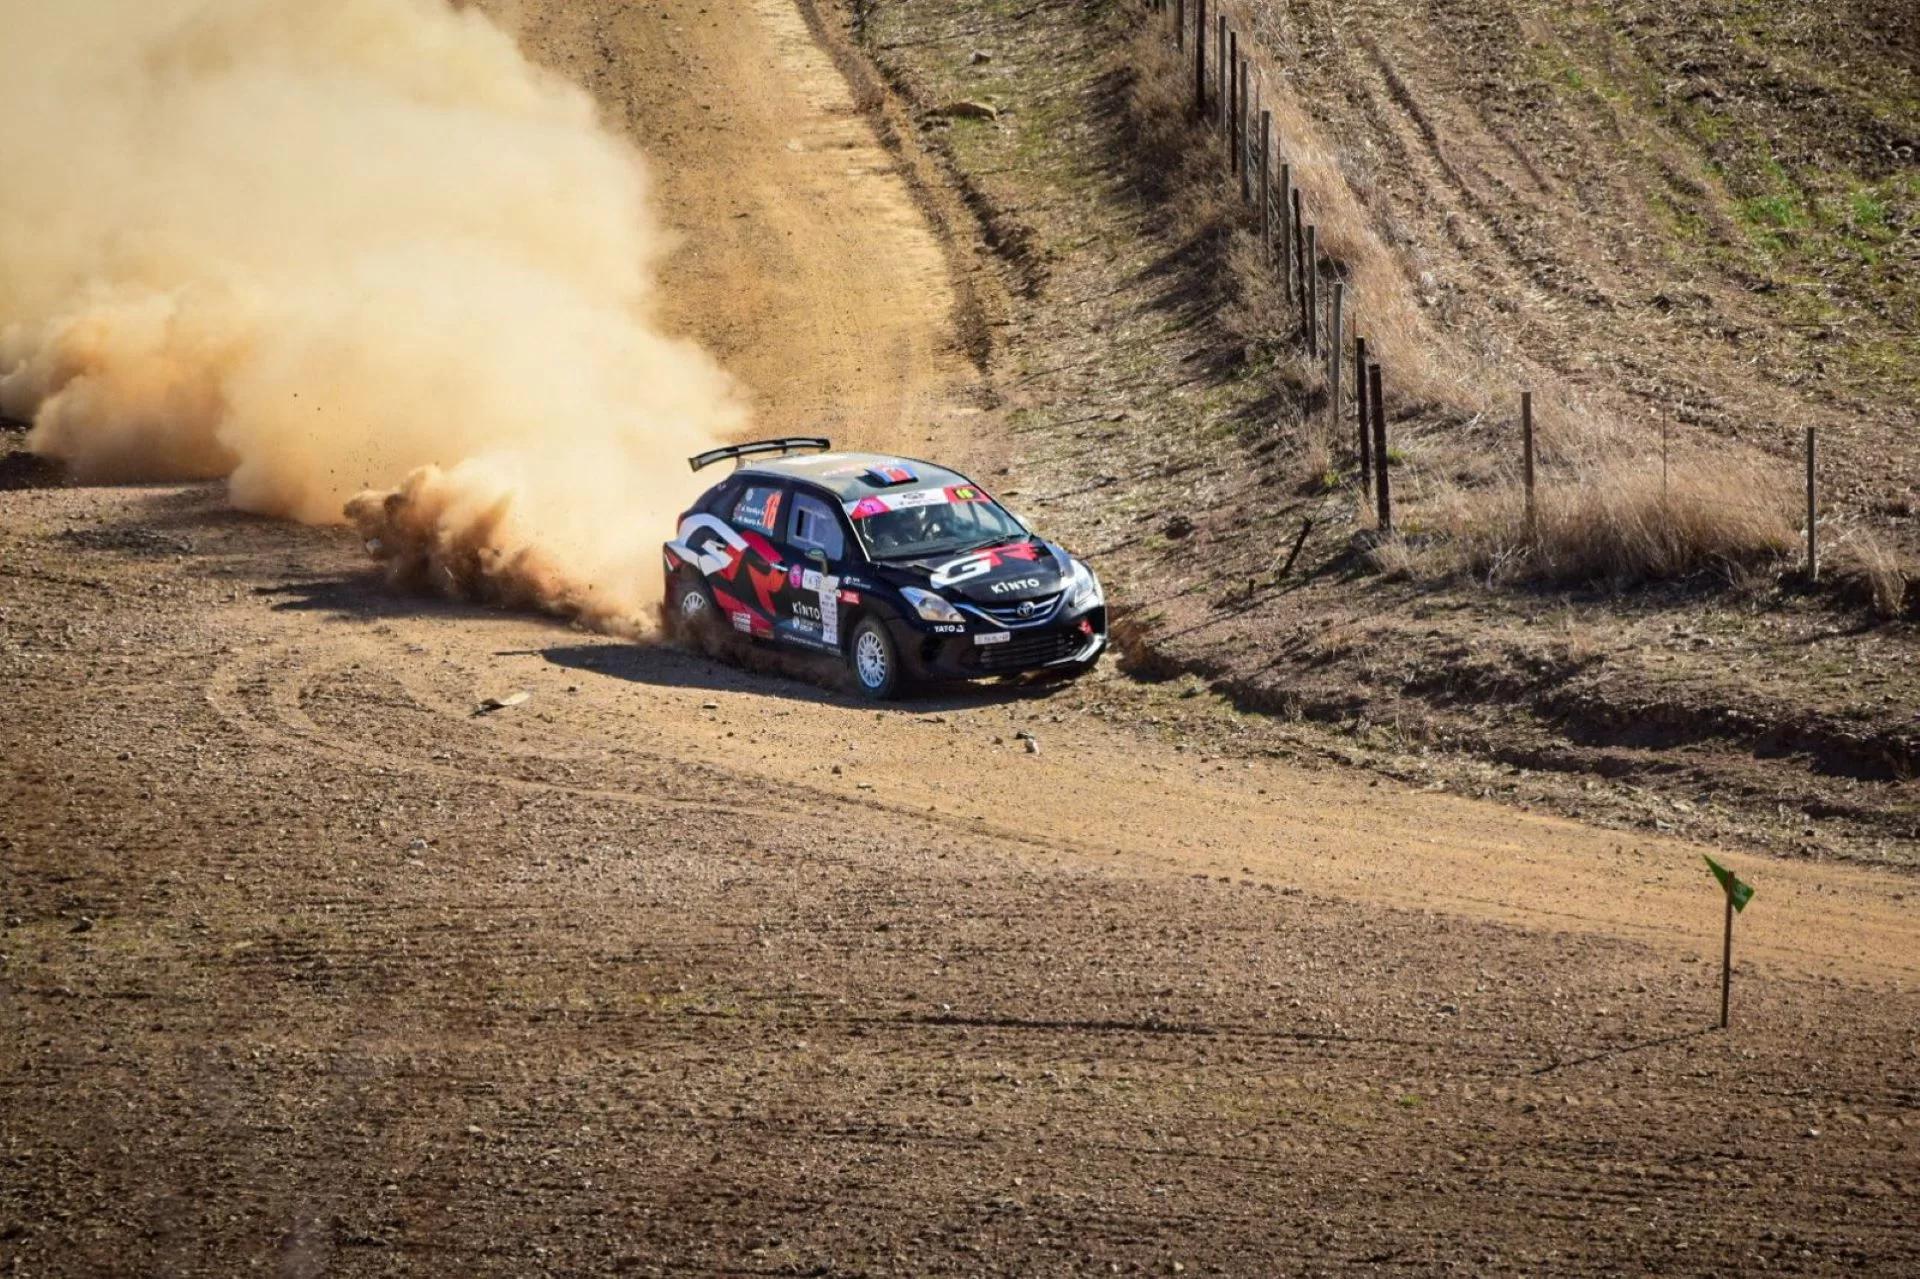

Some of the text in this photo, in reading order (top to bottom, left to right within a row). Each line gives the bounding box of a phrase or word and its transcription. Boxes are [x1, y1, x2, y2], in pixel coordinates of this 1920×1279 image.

[930, 542, 1037, 589] GR
[991, 578, 1040, 594] KINTO
[792, 600, 820, 620] KINTO
[934, 624, 956, 633] YATO
